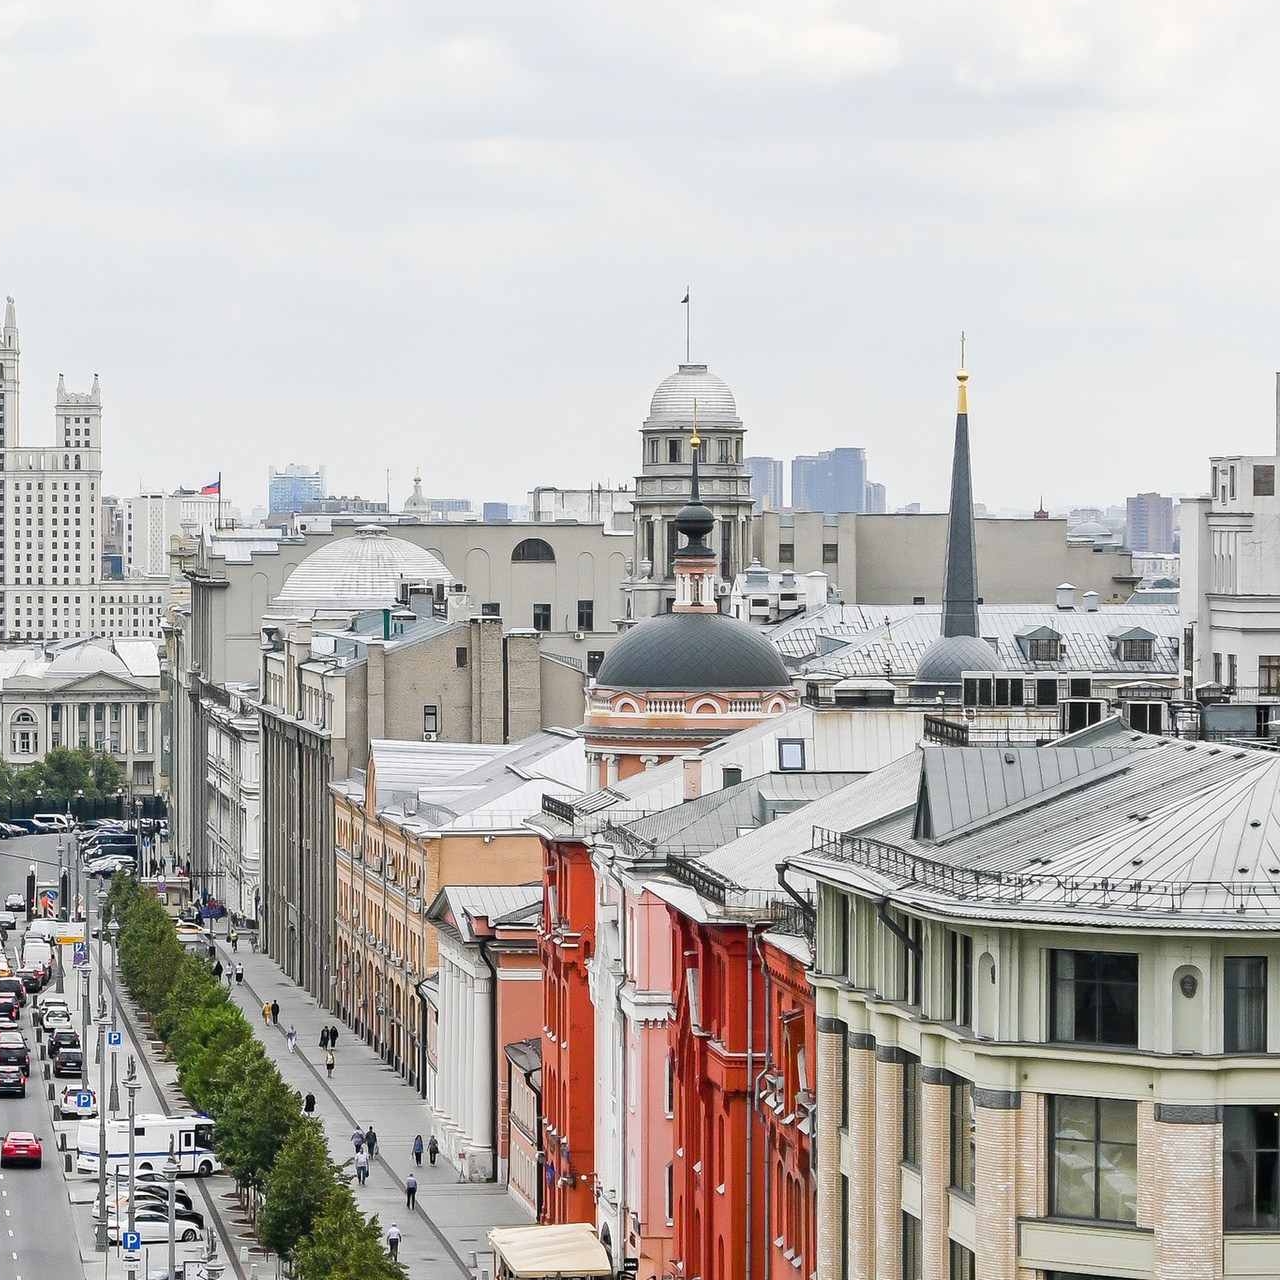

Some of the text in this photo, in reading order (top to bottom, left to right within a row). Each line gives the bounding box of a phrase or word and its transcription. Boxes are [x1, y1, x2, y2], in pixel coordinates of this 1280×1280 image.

[111, 1033, 119, 1044] P
[81, 1095, 89, 1107] P
[127, 1234, 138, 1249] P
